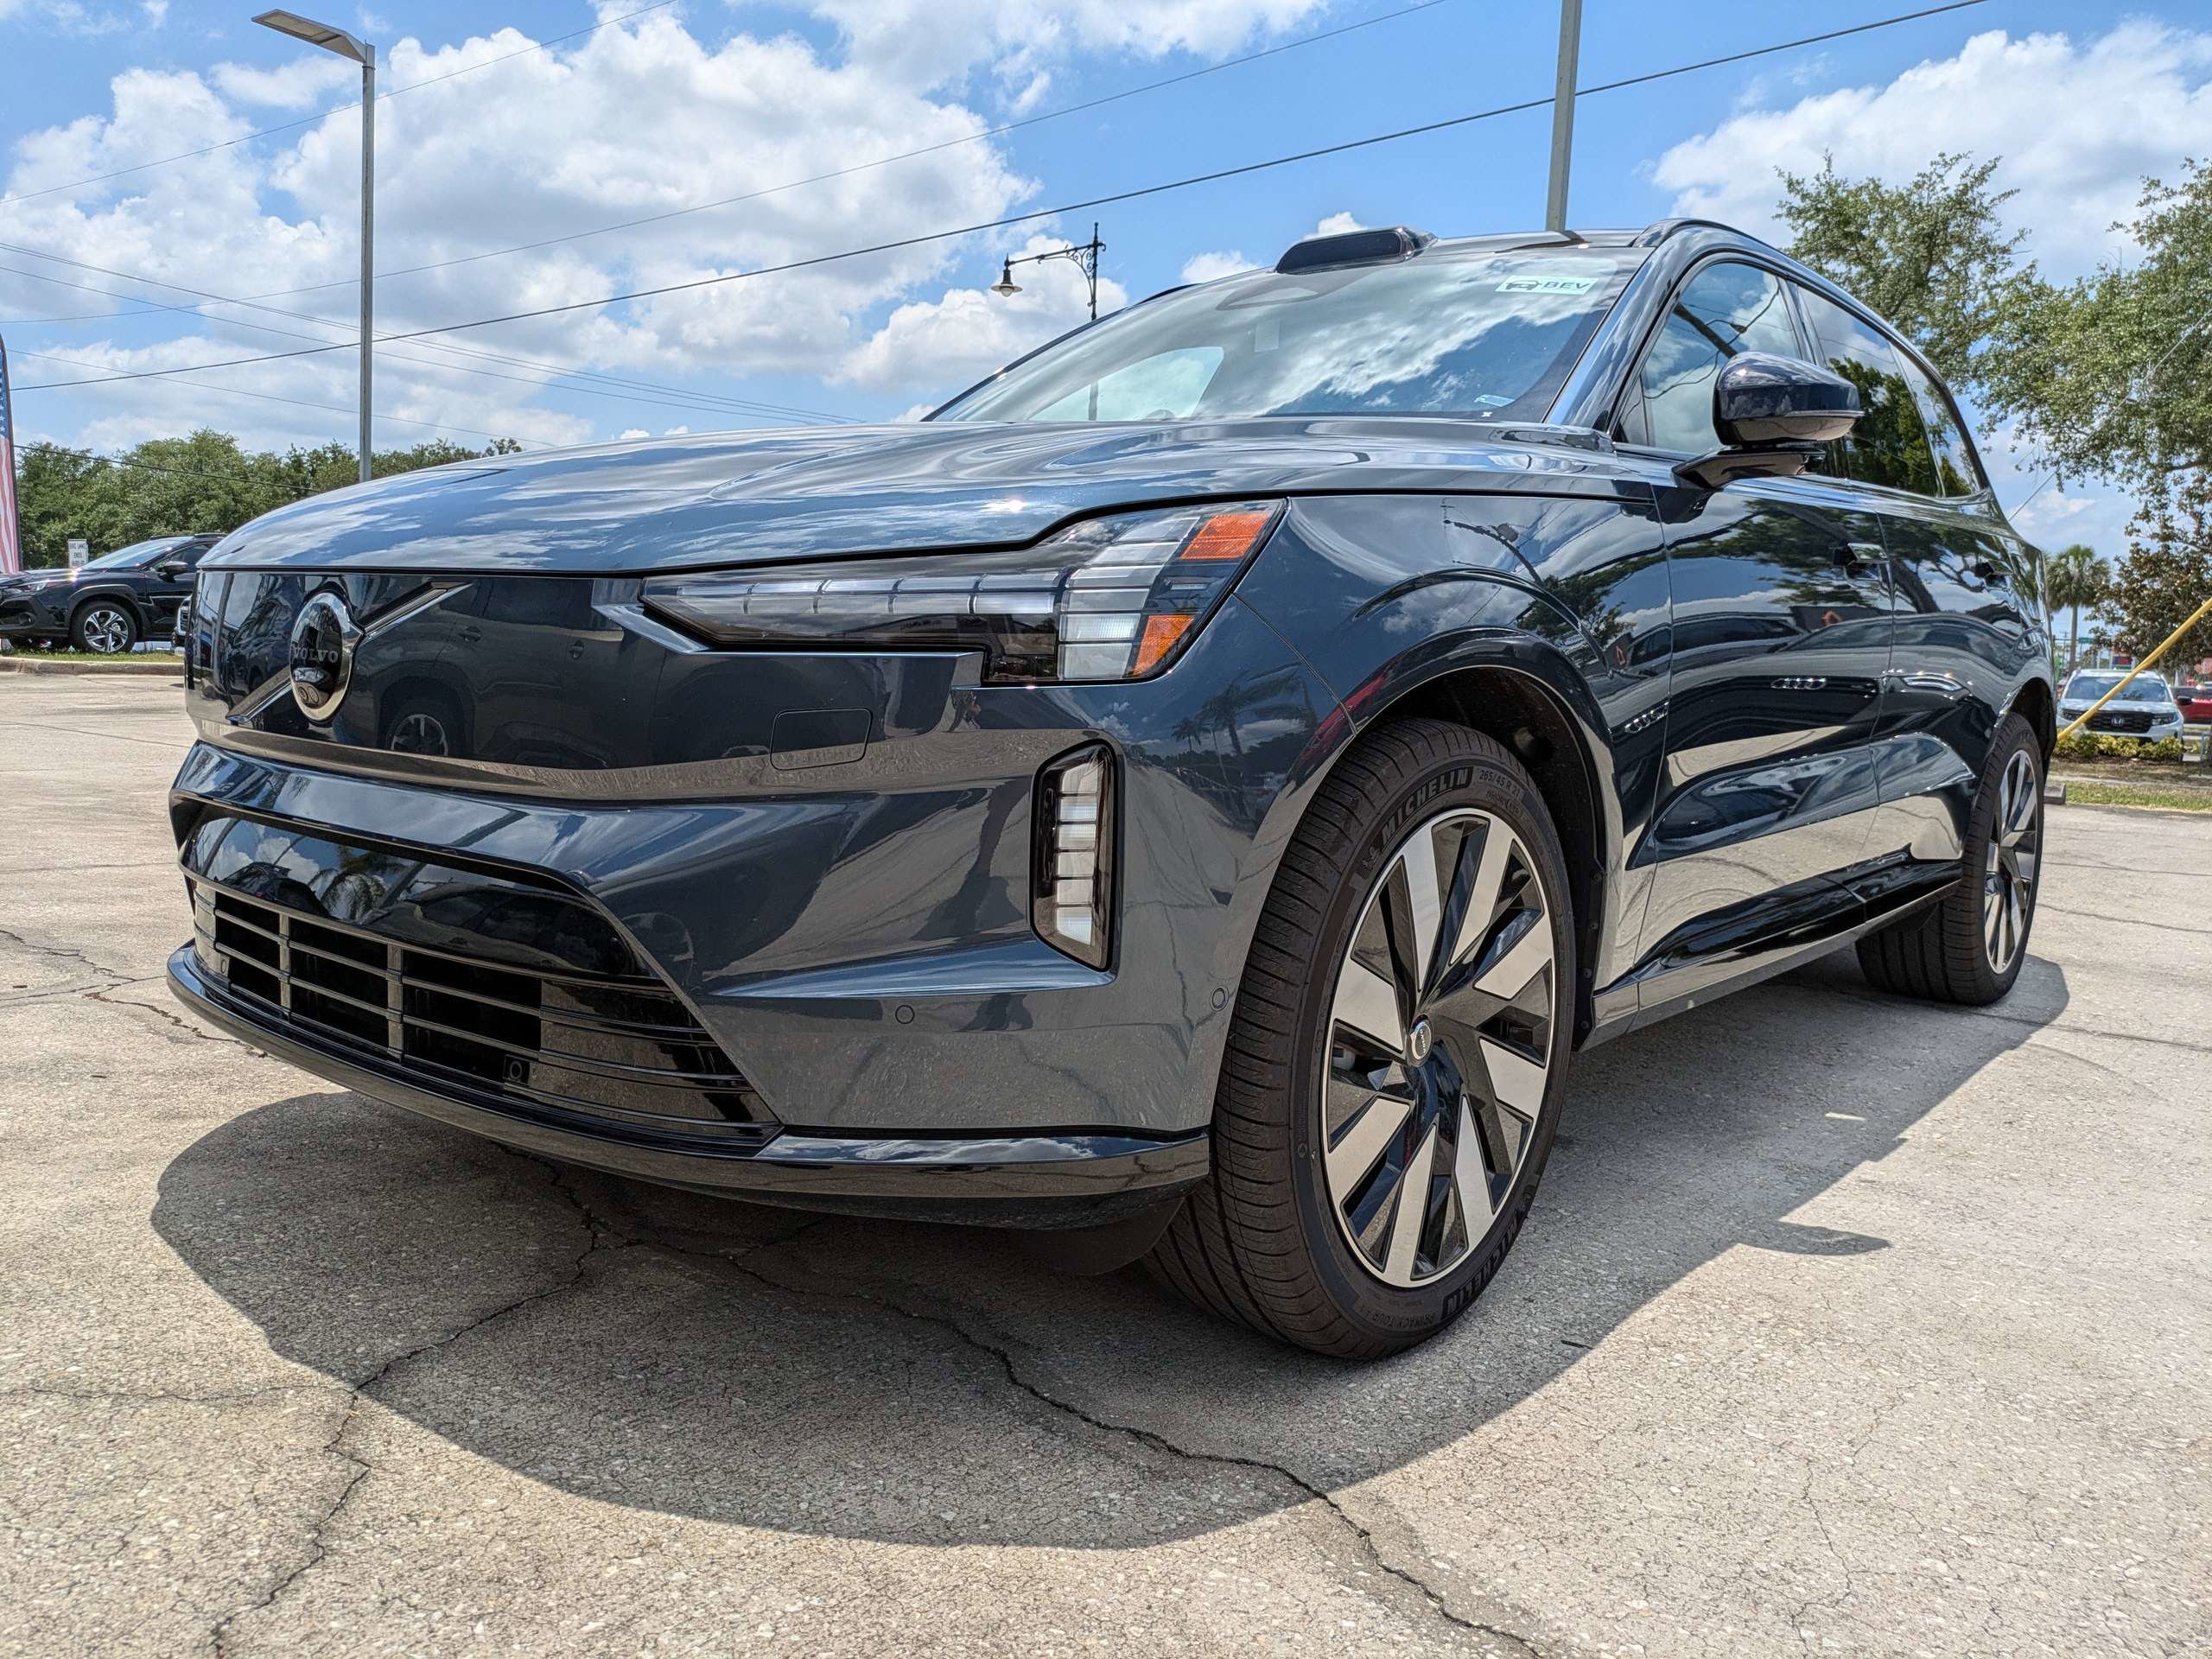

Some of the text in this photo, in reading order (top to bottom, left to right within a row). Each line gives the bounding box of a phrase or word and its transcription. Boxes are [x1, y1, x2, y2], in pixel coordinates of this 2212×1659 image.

[1543, 281, 1590, 289] BEV
[293, 648, 338, 664] VOLVO
[1478, 769, 1506, 786] 265/45
[1381, 766, 1470, 845] MICHELIN
